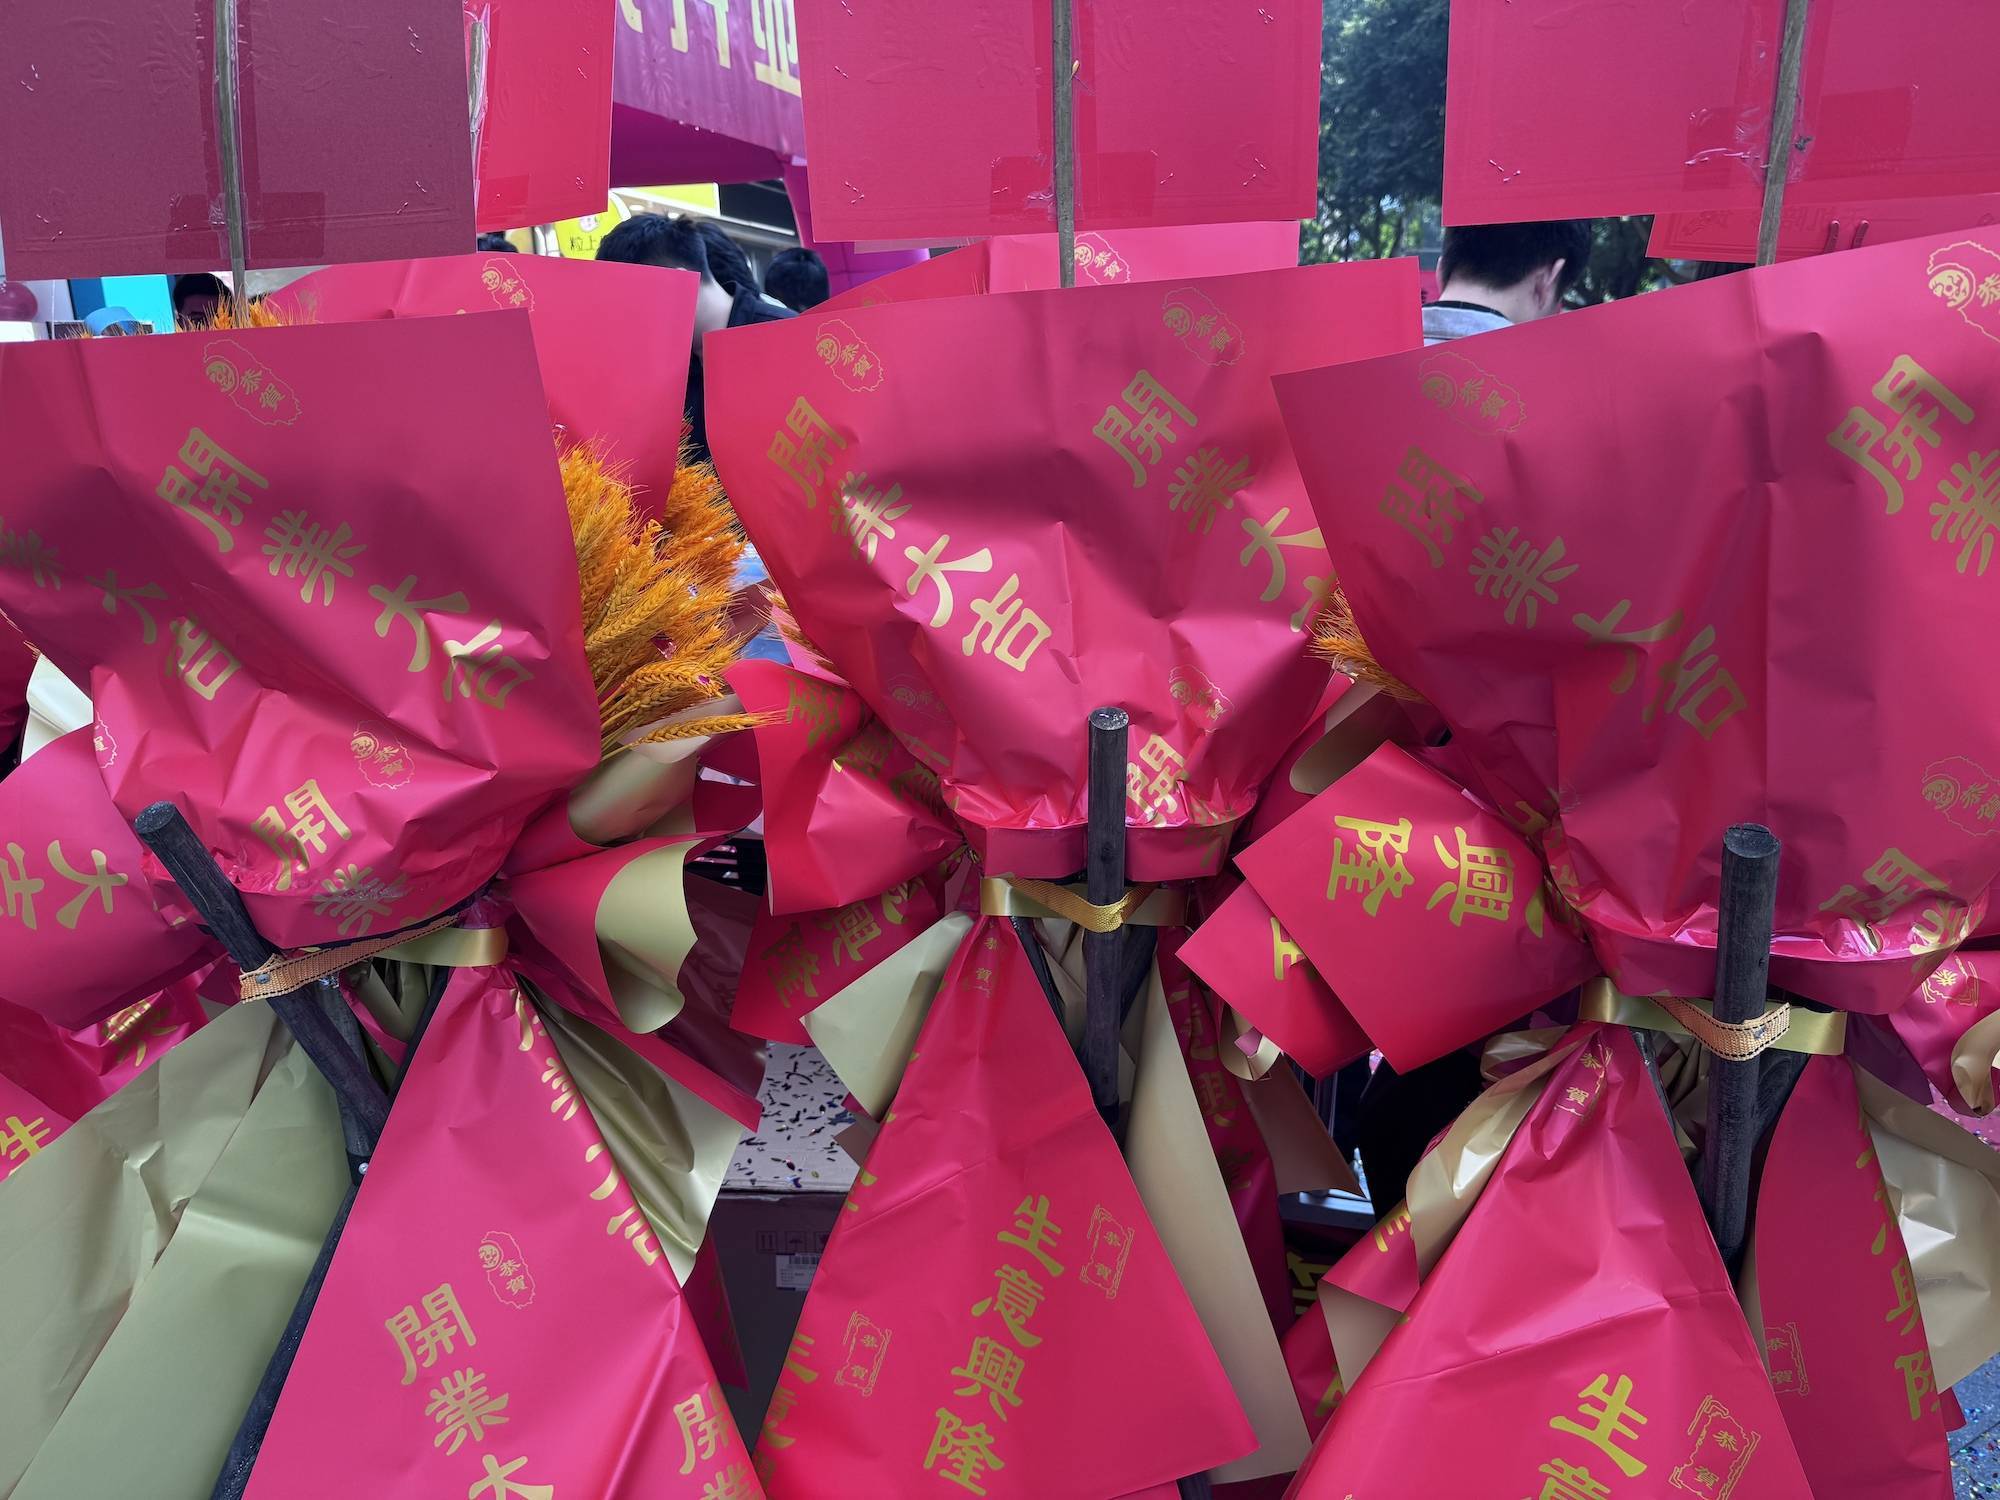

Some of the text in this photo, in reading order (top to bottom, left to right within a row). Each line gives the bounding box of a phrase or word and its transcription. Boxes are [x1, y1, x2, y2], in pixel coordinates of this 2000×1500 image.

[156, 427, 535, 710] 開業大吉
[767, 396, 1053, 672] 開業大吉
[1379, 446, 1748, 740] 開業大吉
[499, 1257, 529, 1296] 恭賀
[923, 1195, 1064, 1496] 生意興隆
